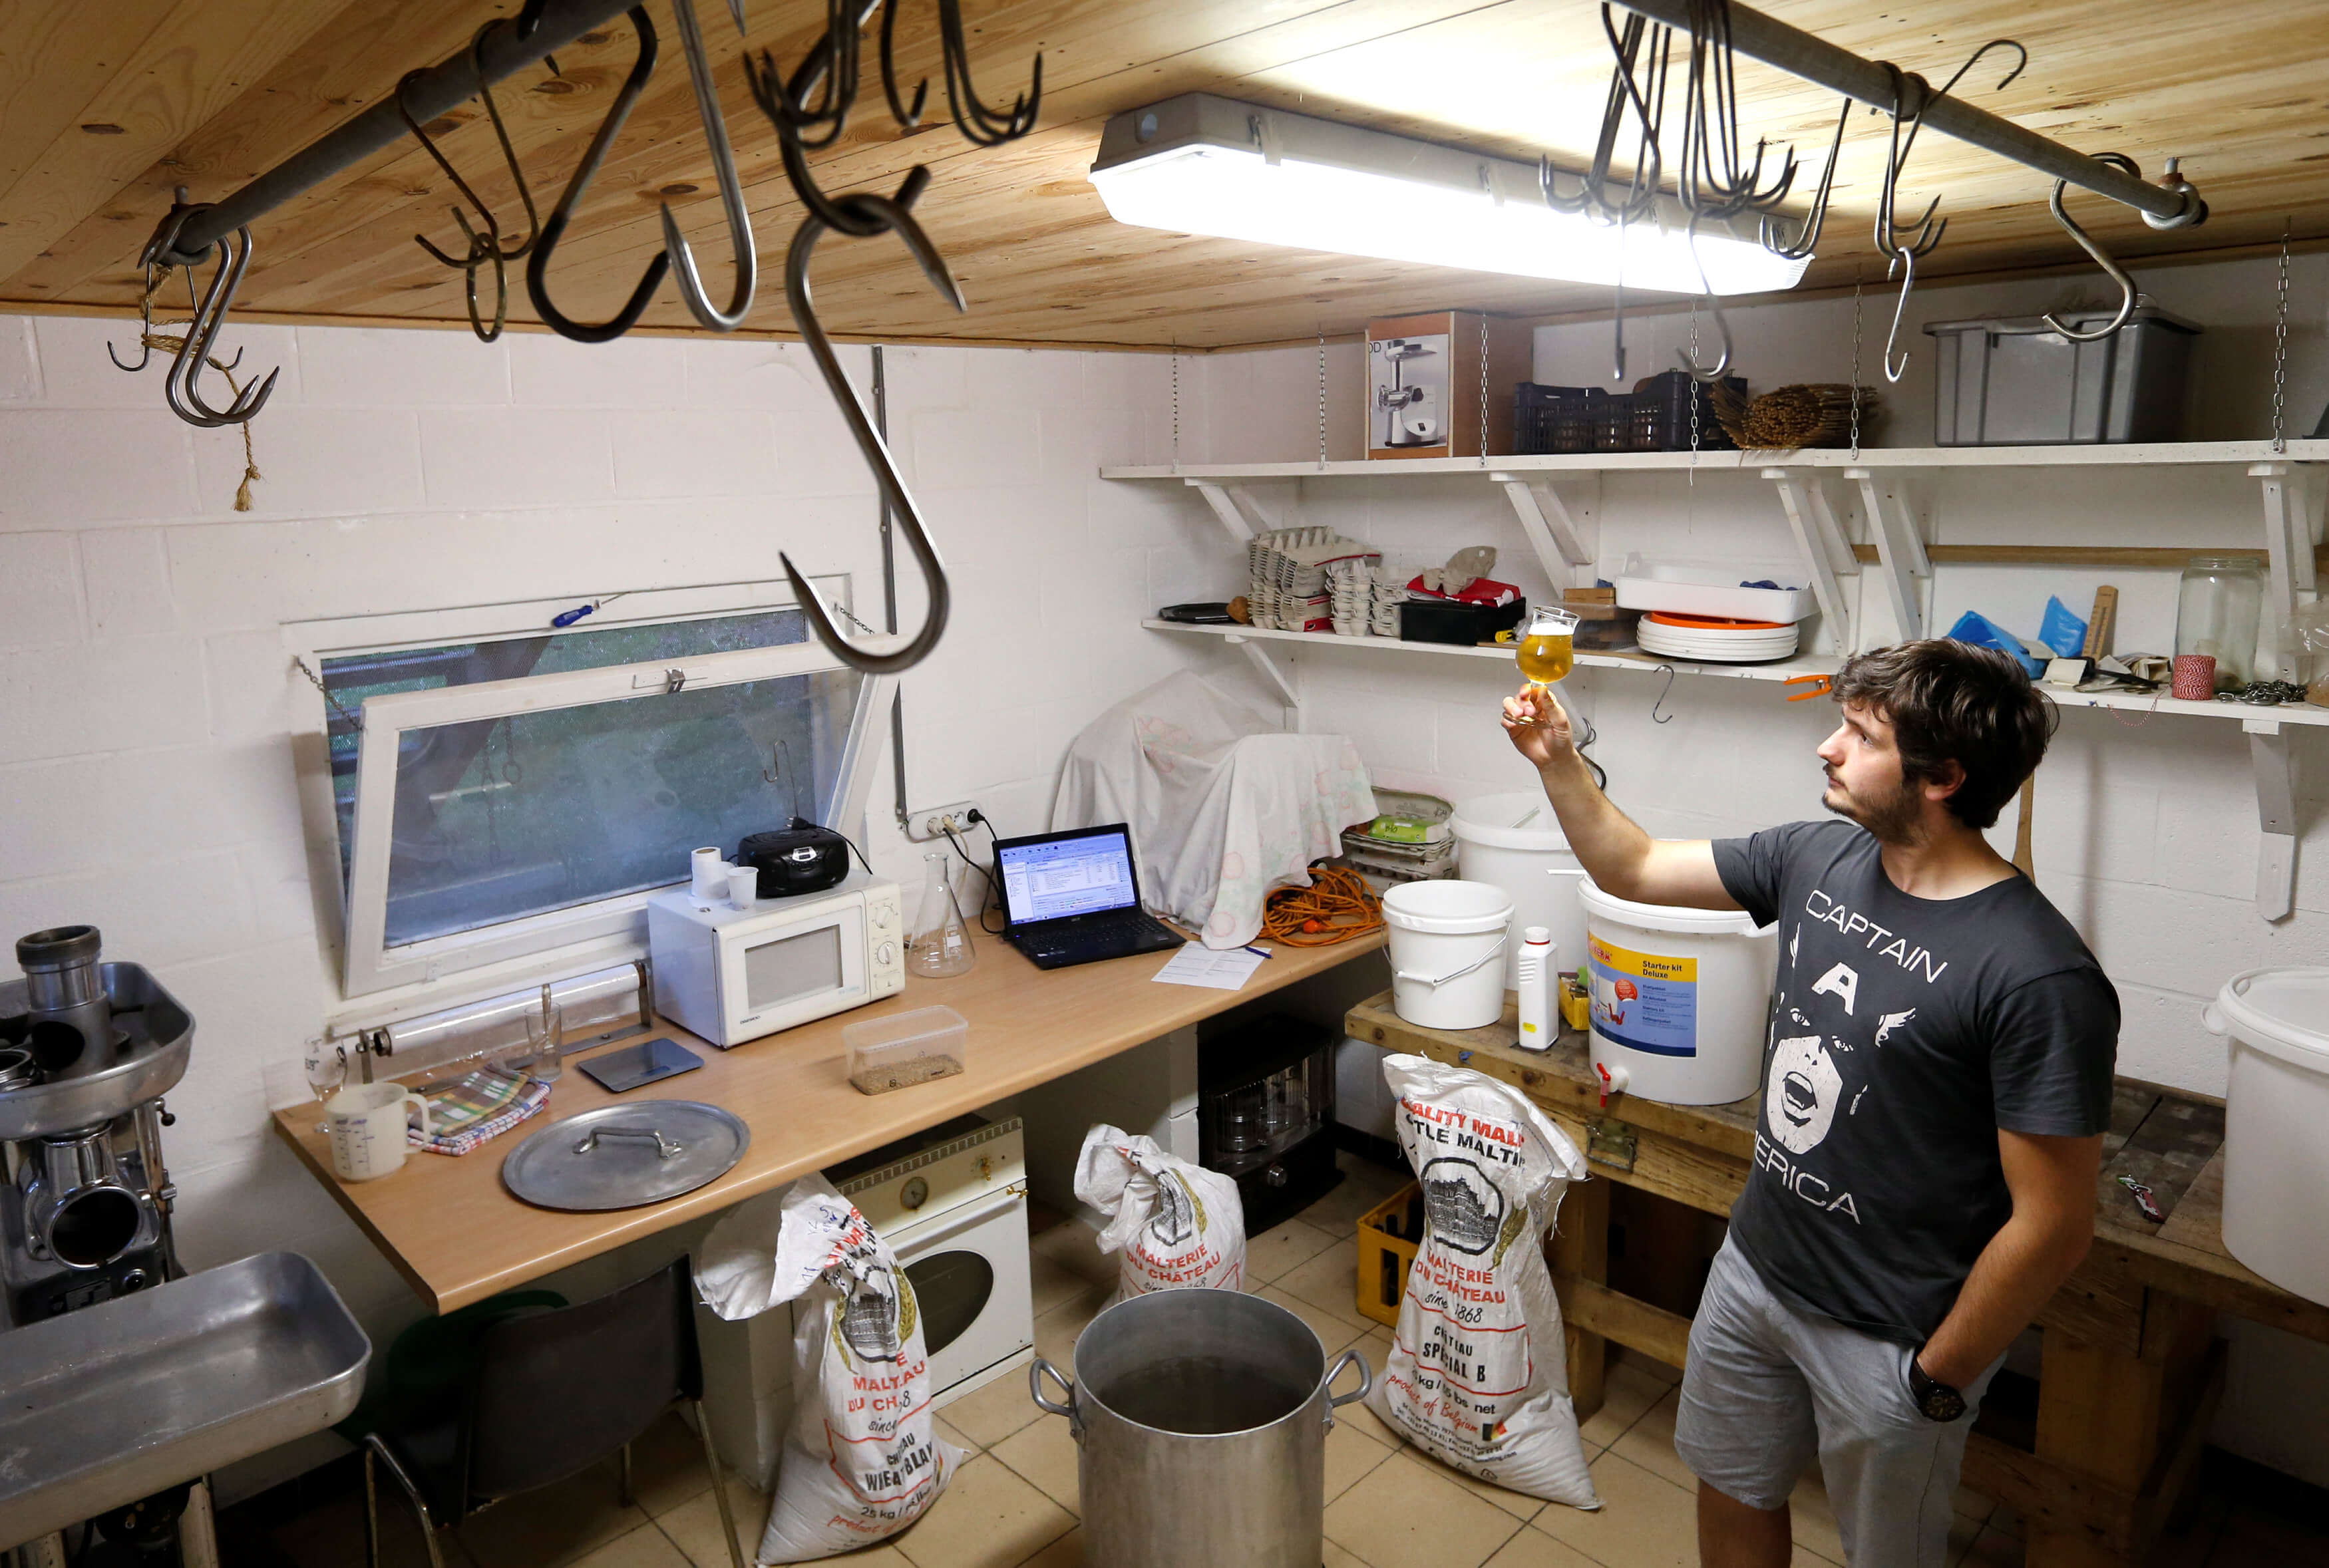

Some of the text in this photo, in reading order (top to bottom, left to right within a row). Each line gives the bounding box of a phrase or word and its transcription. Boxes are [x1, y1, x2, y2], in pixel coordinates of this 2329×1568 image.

[1806, 889, 1948, 983] CAPTAIN
[1642, 960, 1670, 971] Starter
[1642, 969, 1668, 979] Deluxe
[1811, 962, 1858, 1016] A
[1406, 1114, 1449, 1144] TLE
[1126, 1251, 1221, 1283] DU CHÂTEAU
[1135, 1243, 1208, 1270] MALTERIE
[1427, 1250, 1493, 1285] MALTERIE
[1415, 1260, 1431, 1281] DU
[1455, 1304, 1483, 1323] 1868
[1477, 1364, 1485, 1382] B
[848, 1398, 865, 1412] DU
[1419, 1374, 1434, 1389] kg
[1475, 1404, 1495, 1414] net
[1423, 1397, 1439, 1416] of
[1441, 1402, 1479, 1434] Belgium
[860, 1506, 876, 1519] 25
[880, 1509, 895, 1520] kg
